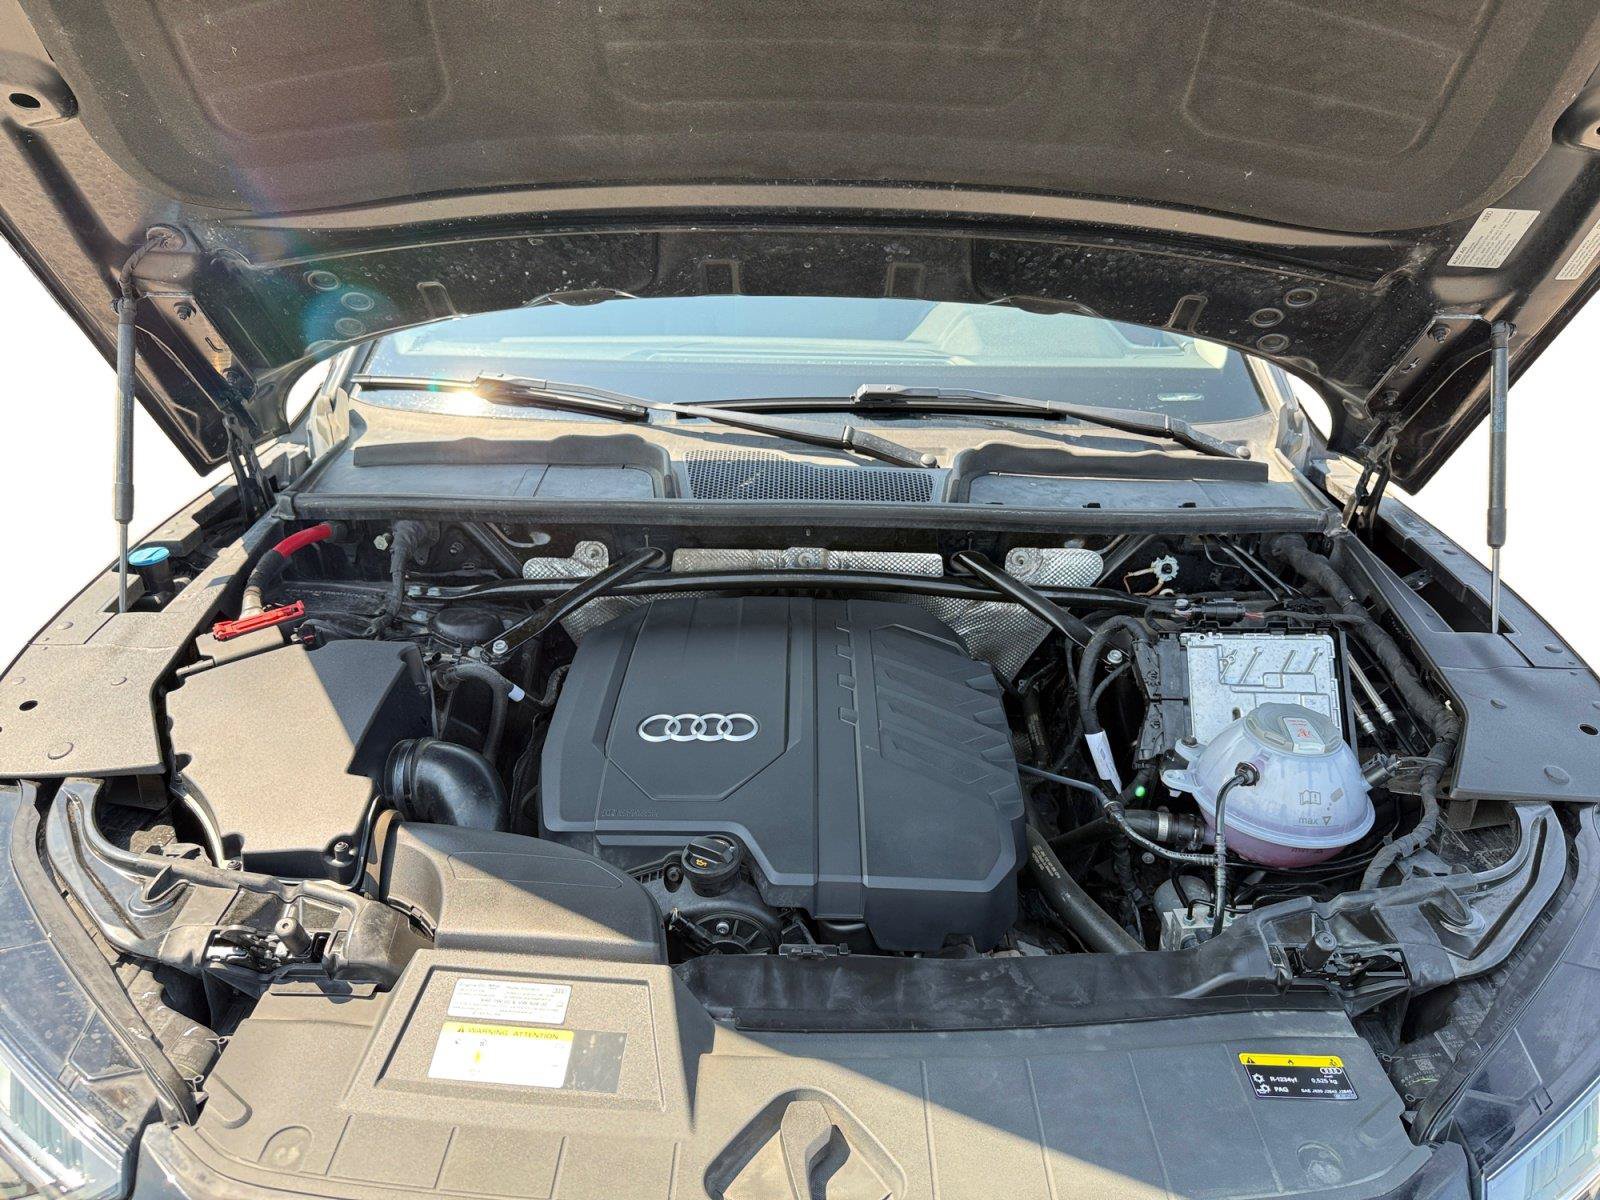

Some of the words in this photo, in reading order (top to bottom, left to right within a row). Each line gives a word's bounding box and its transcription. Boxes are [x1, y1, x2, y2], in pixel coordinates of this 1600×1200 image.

[1298, 816, 1318, 825] max
[468, 1027, 509, 1037] WARNING
[513, 1030, 559, 1040] ATTENTION
[1269, 1076, 1298, 1084] R-1234yf
